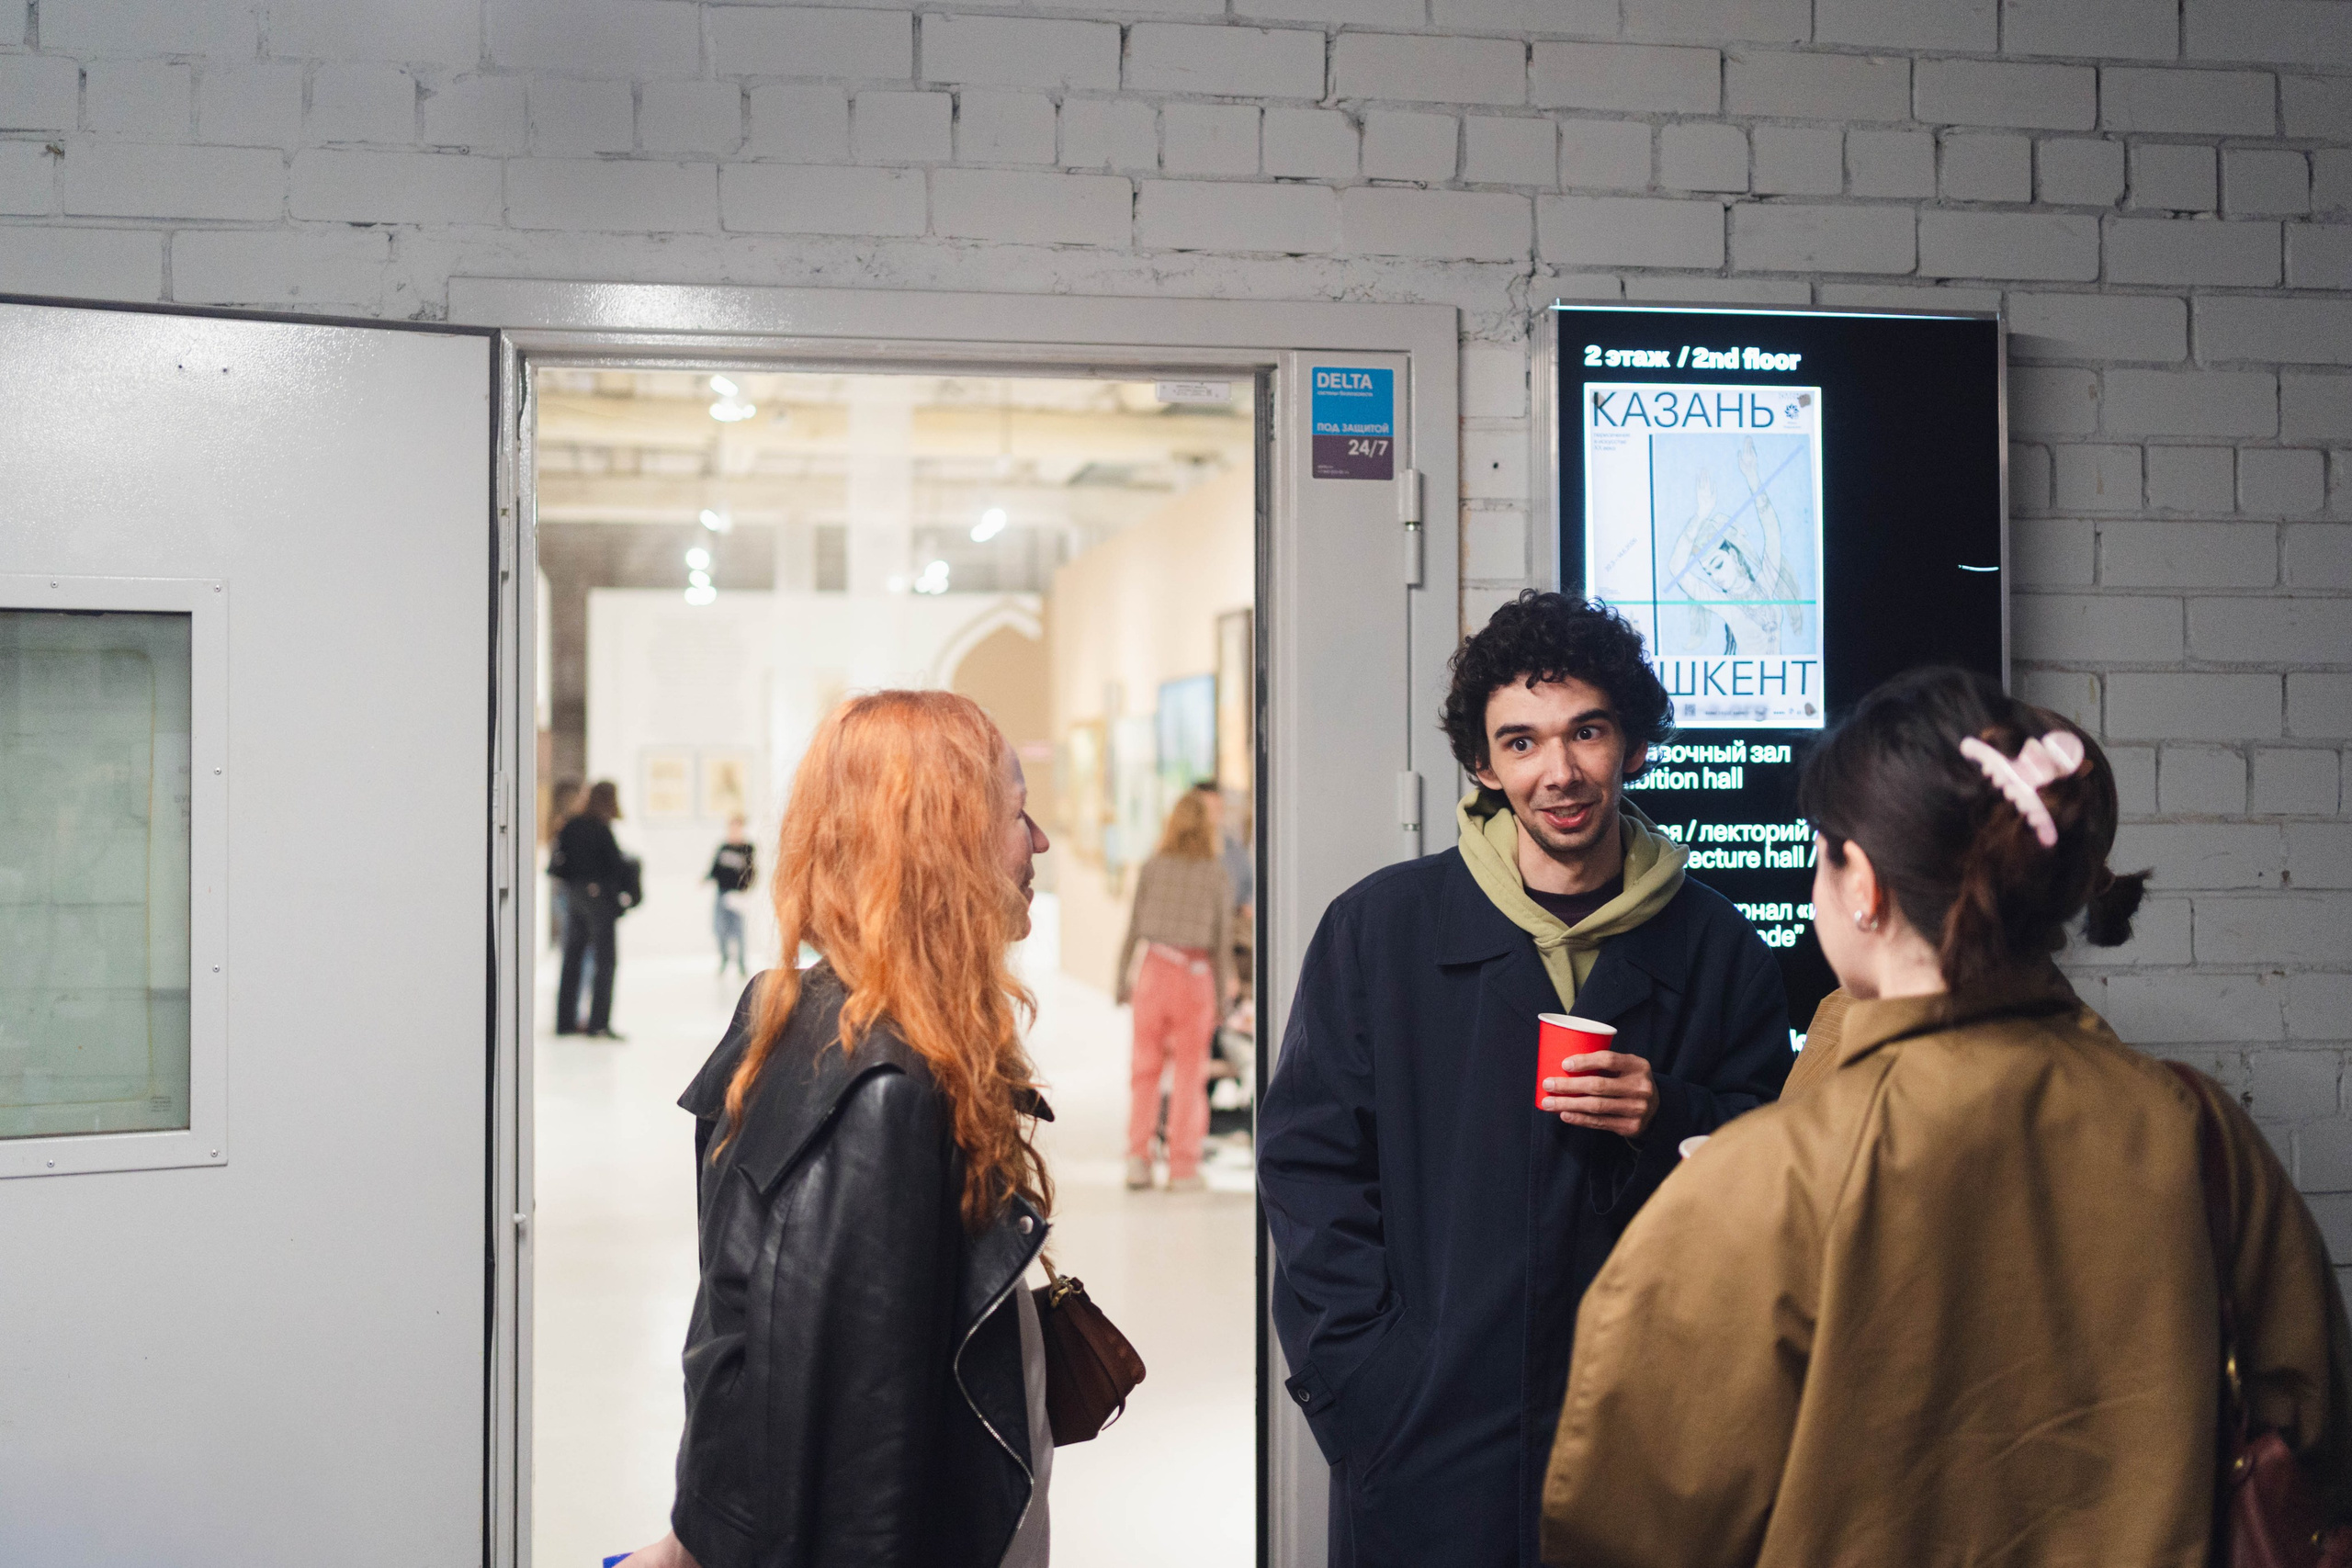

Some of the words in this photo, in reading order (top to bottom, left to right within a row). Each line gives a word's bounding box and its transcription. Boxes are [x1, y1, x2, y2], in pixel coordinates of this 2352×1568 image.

[1584, 344, 1603, 367] 2
[1605, 349, 1671, 368] этаж
[1677, 345, 1690, 368] /
[1692, 346, 1740, 370] 2nd
[1742, 346, 1802, 371] floor
[1317, 372, 1373, 389] DELTA
[1593, 391, 1775, 428] КАЗАНЬ
[1317, 423, 1340, 433] ПОД
[1342, 423, 1389, 434] ЗАЩИТОЙ
[1348, 439, 1388, 458] 24/7
[1749, 745, 1791, 763] зал
[1702, 766, 1744, 789] hall
[1698, 818, 1809, 846] лекторий
[1683, 847, 1761, 868] ecture
[1765, 844, 1804, 868] hall
